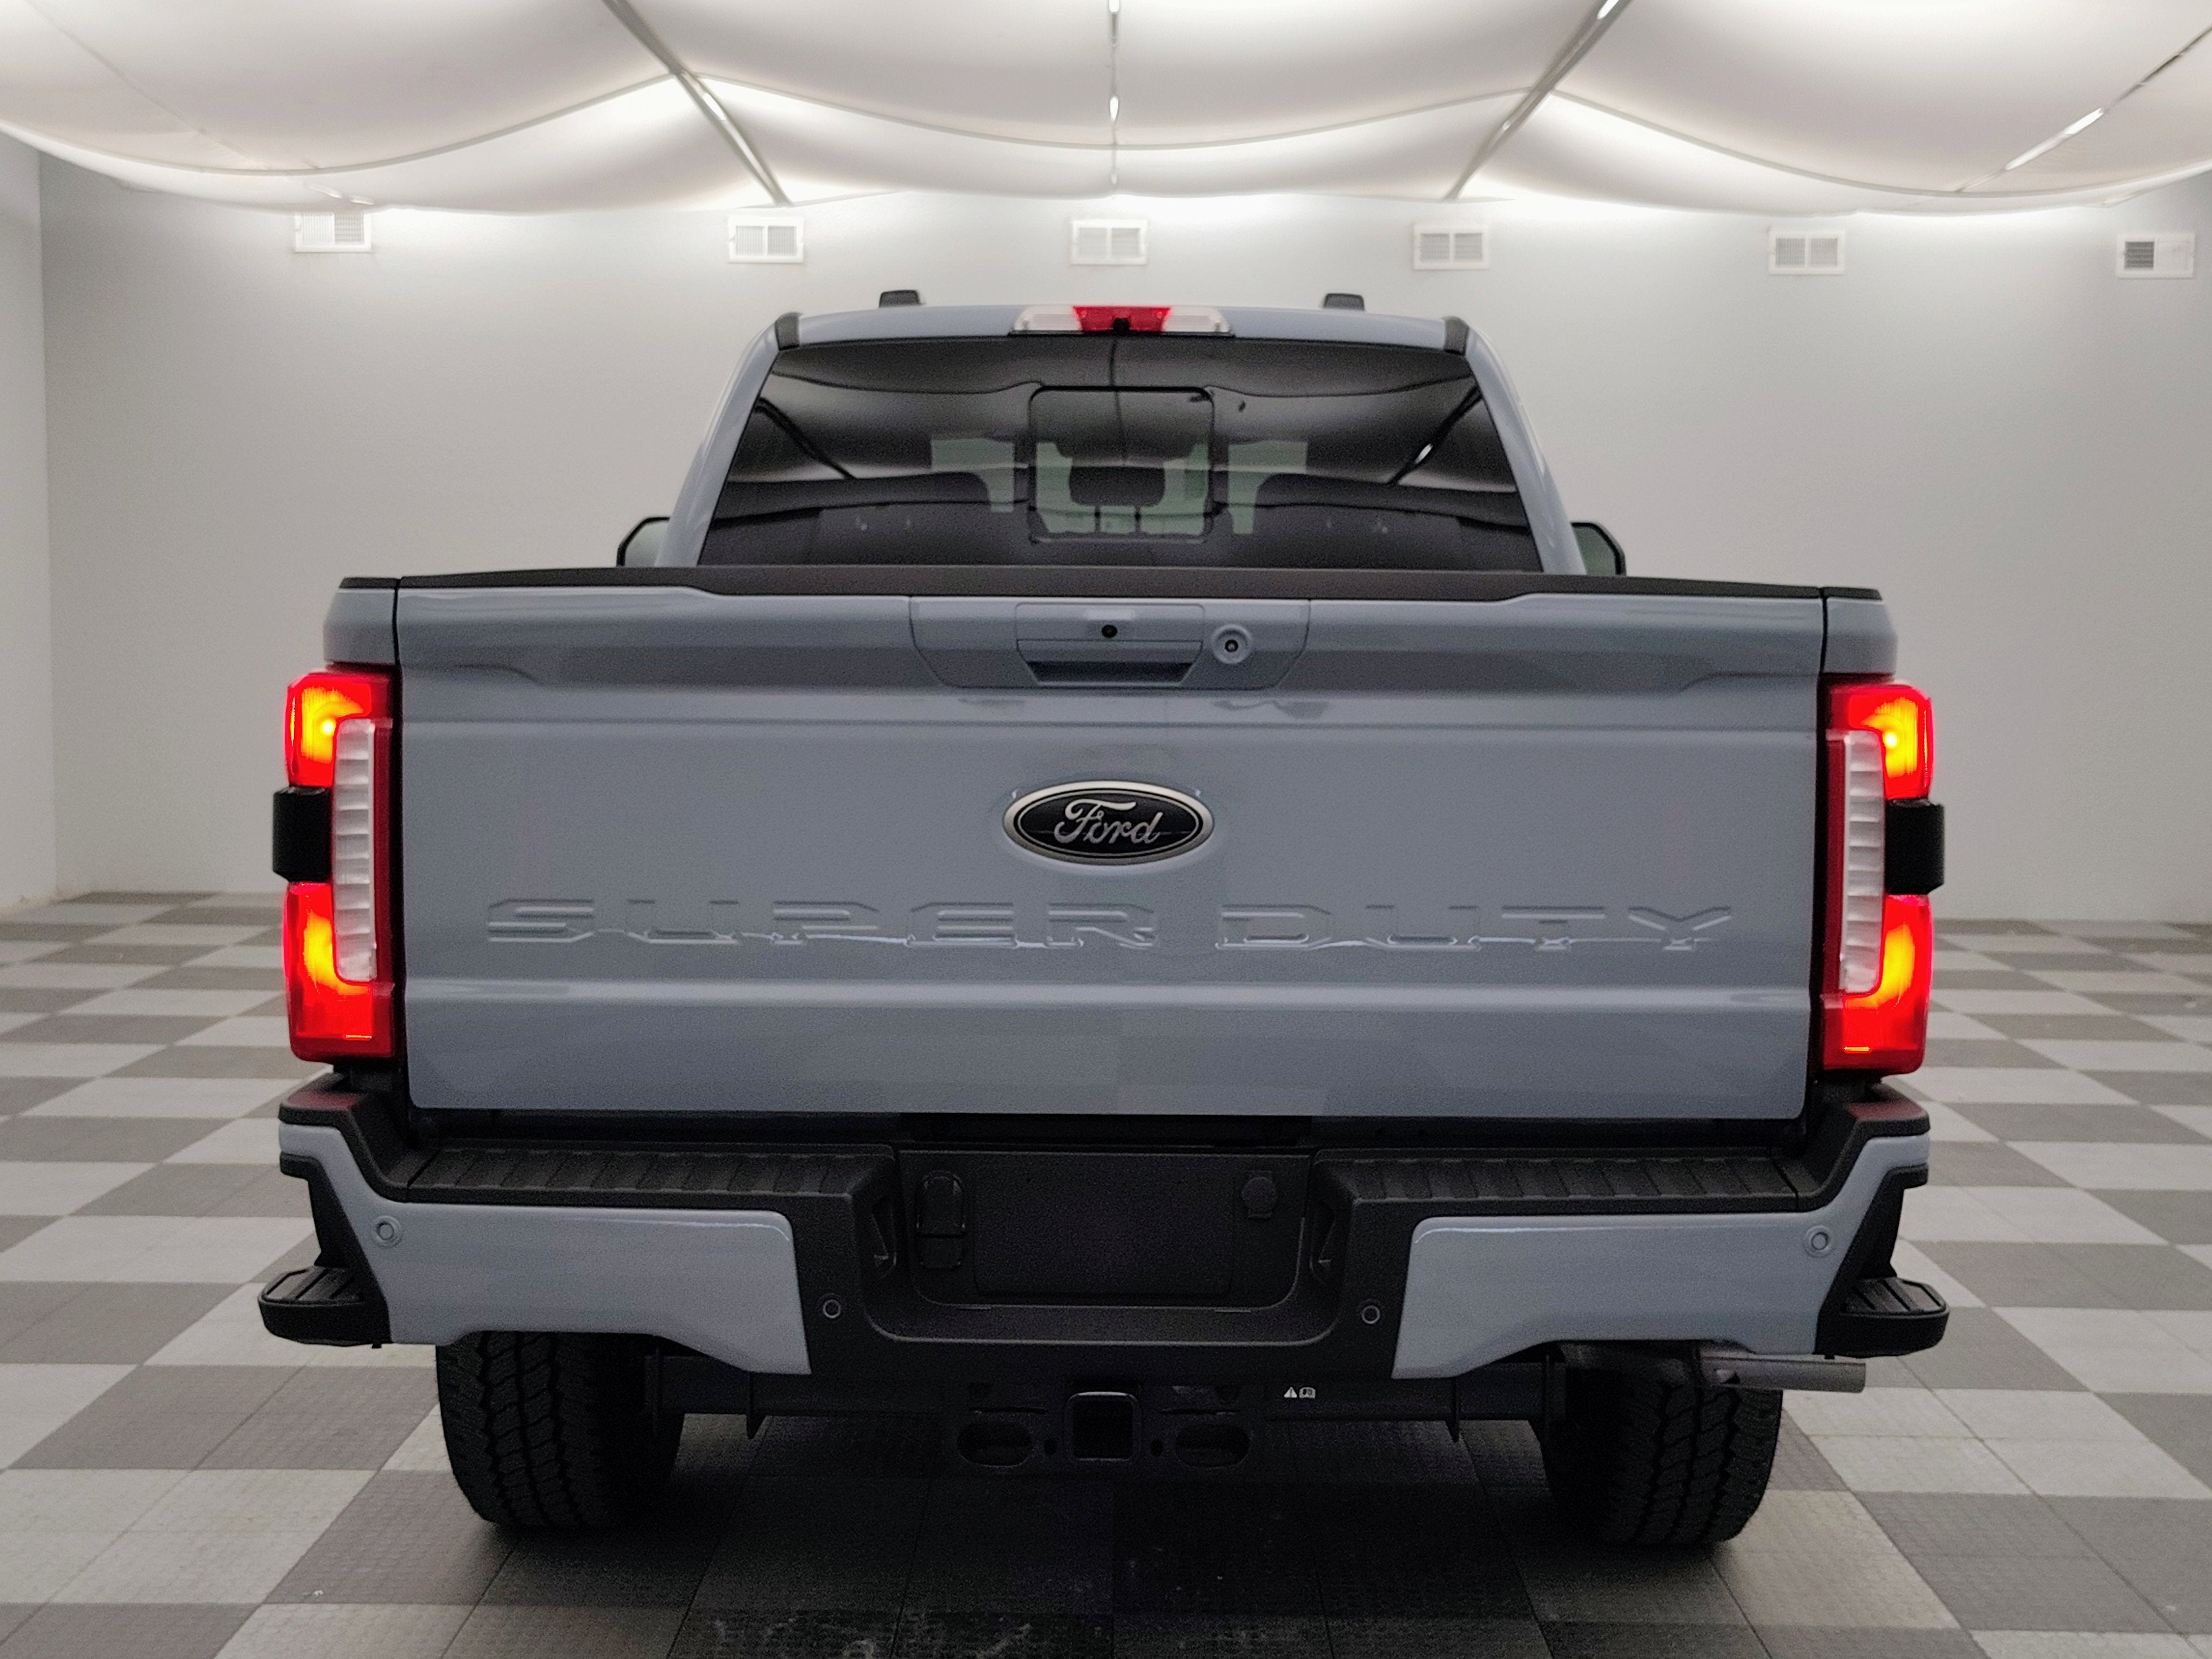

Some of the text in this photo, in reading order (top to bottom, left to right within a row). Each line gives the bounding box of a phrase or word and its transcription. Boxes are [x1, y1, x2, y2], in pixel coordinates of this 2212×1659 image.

[1054, 798, 1164, 844] Ford
[487, 899, 1731, 952] SUPER DUTY
